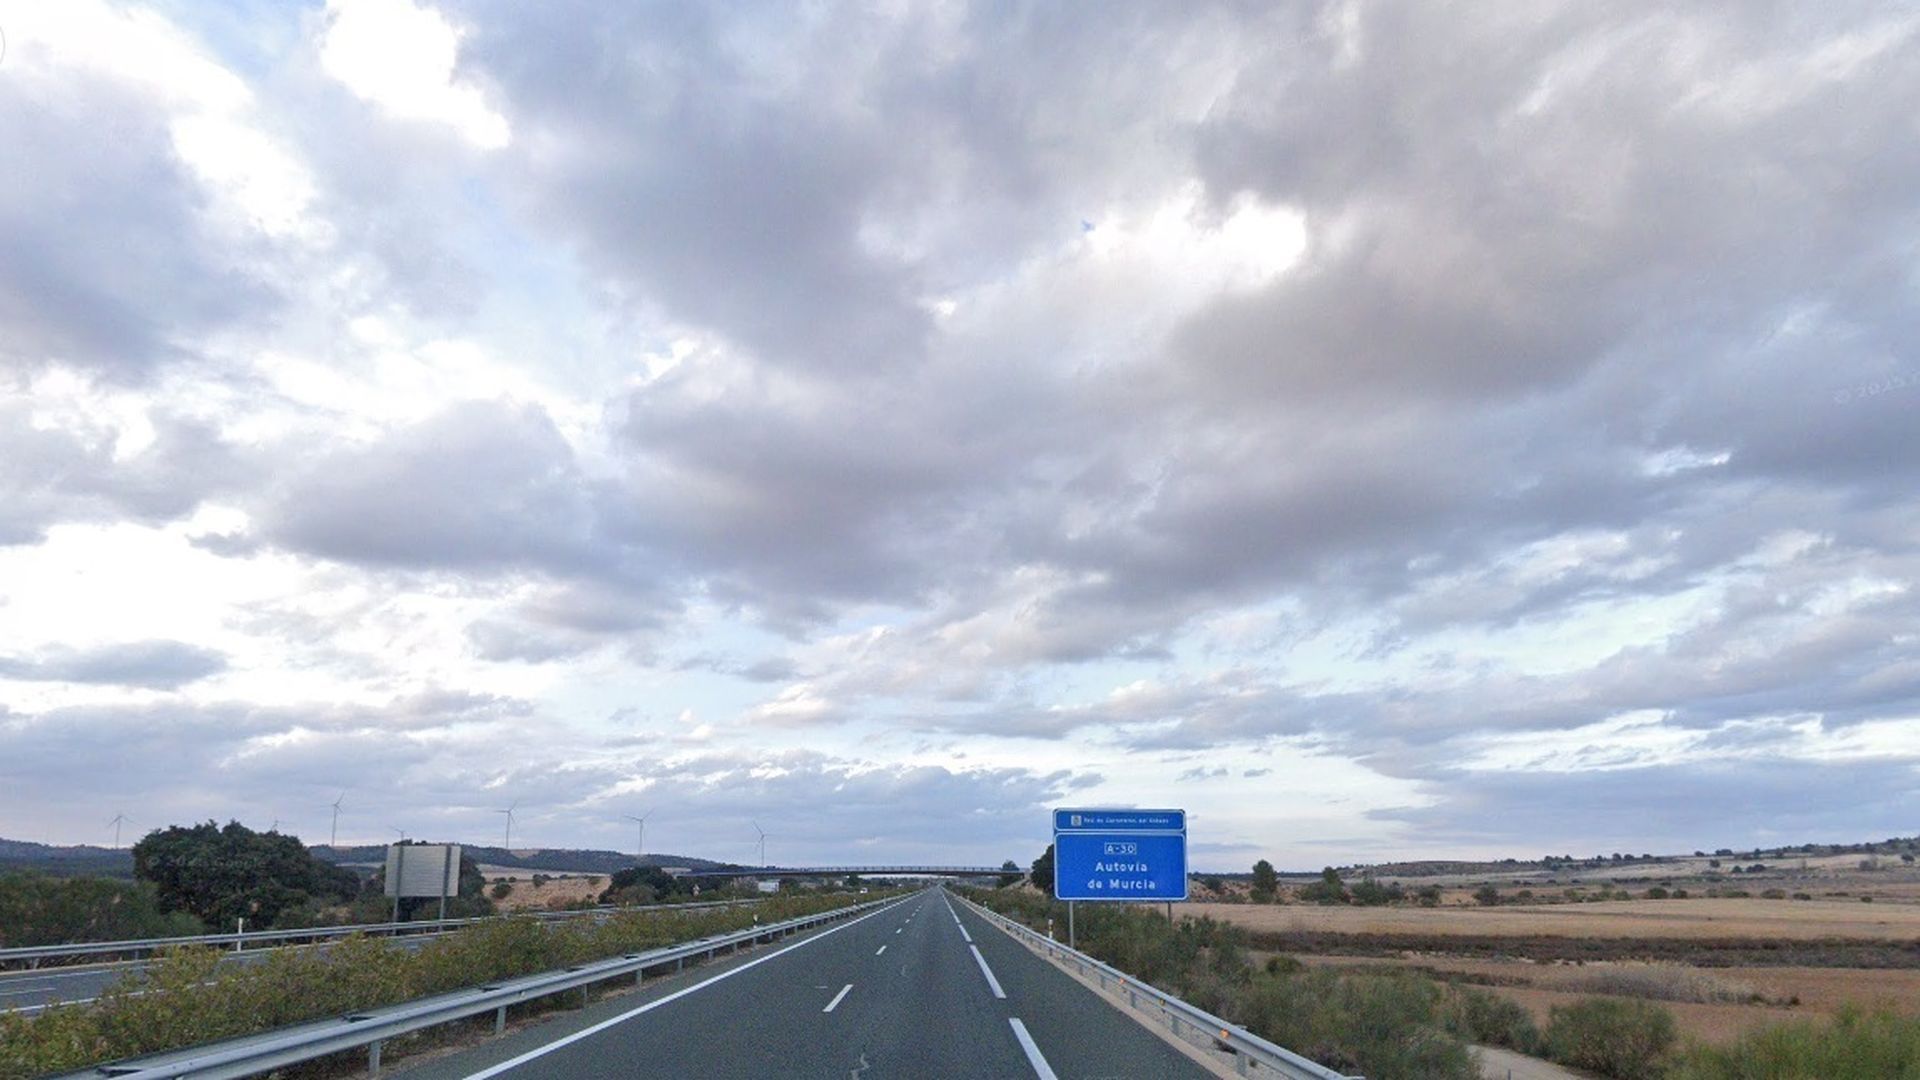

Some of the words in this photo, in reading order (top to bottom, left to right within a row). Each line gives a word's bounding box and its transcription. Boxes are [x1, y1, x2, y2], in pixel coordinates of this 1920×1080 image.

[1106, 844, 1135, 853] A-30
[1087, 879, 1103, 889] de
[1109, 879, 1156, 890] Murcia
